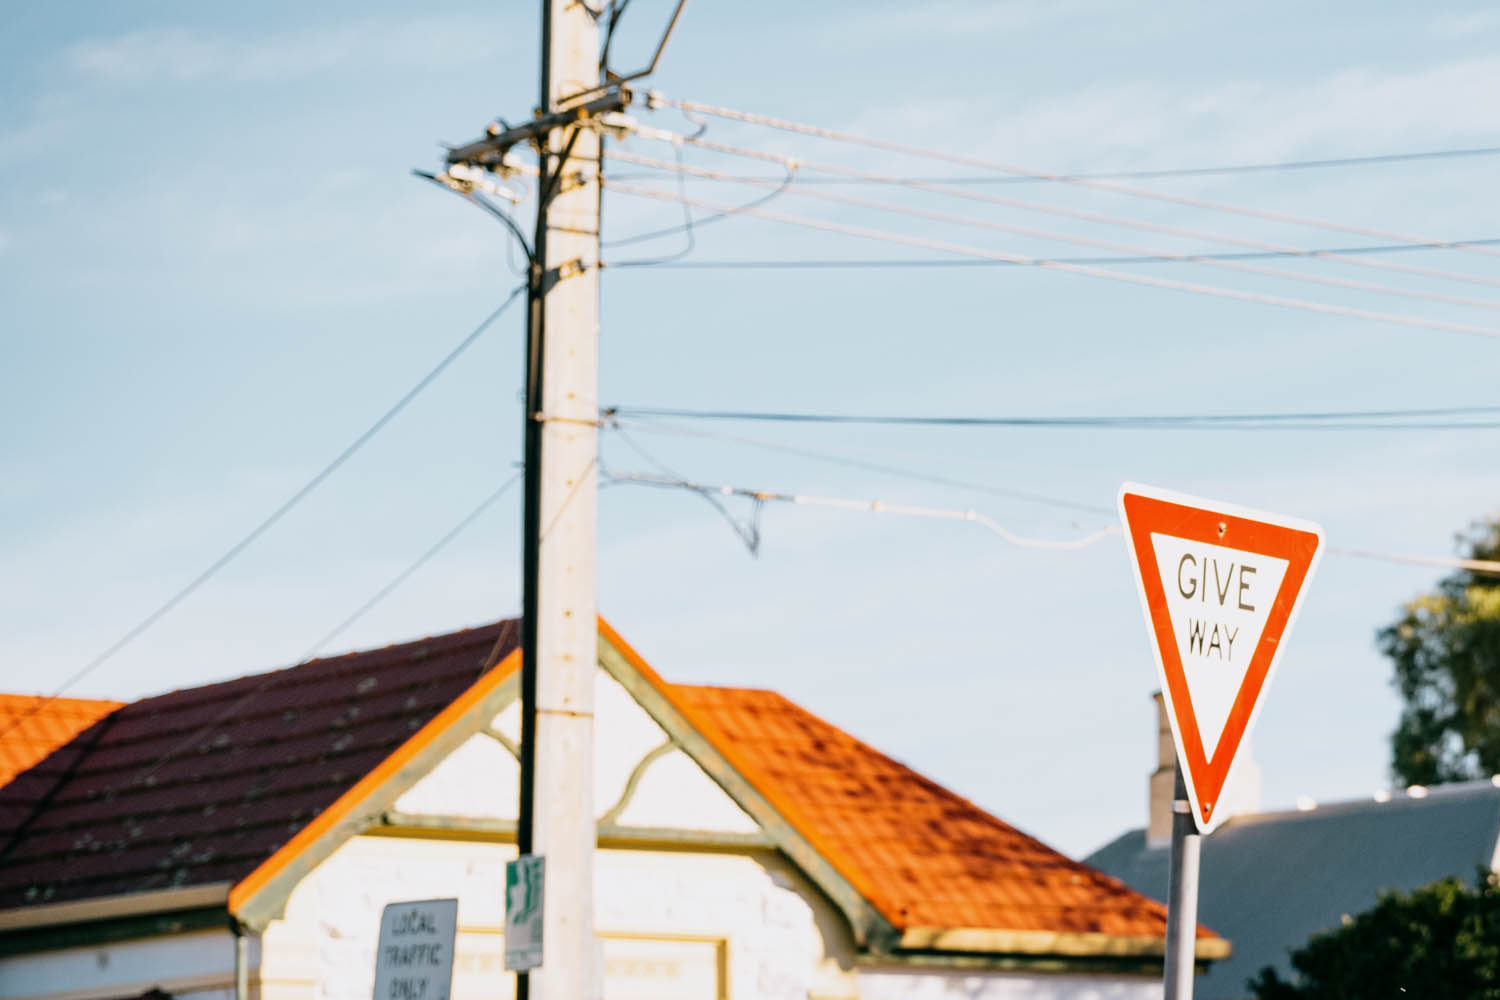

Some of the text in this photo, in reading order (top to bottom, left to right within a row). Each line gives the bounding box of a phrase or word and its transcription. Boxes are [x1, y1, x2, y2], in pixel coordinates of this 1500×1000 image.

[1178, 553, 1257, 612] GIVE
[1189, 617, 1239, 663] WAY
[391, 913, 438, 936] LOCAL
[384, 944, 443, 967] TRAFFIC
[388, 977, 429, 1000] ONLY
